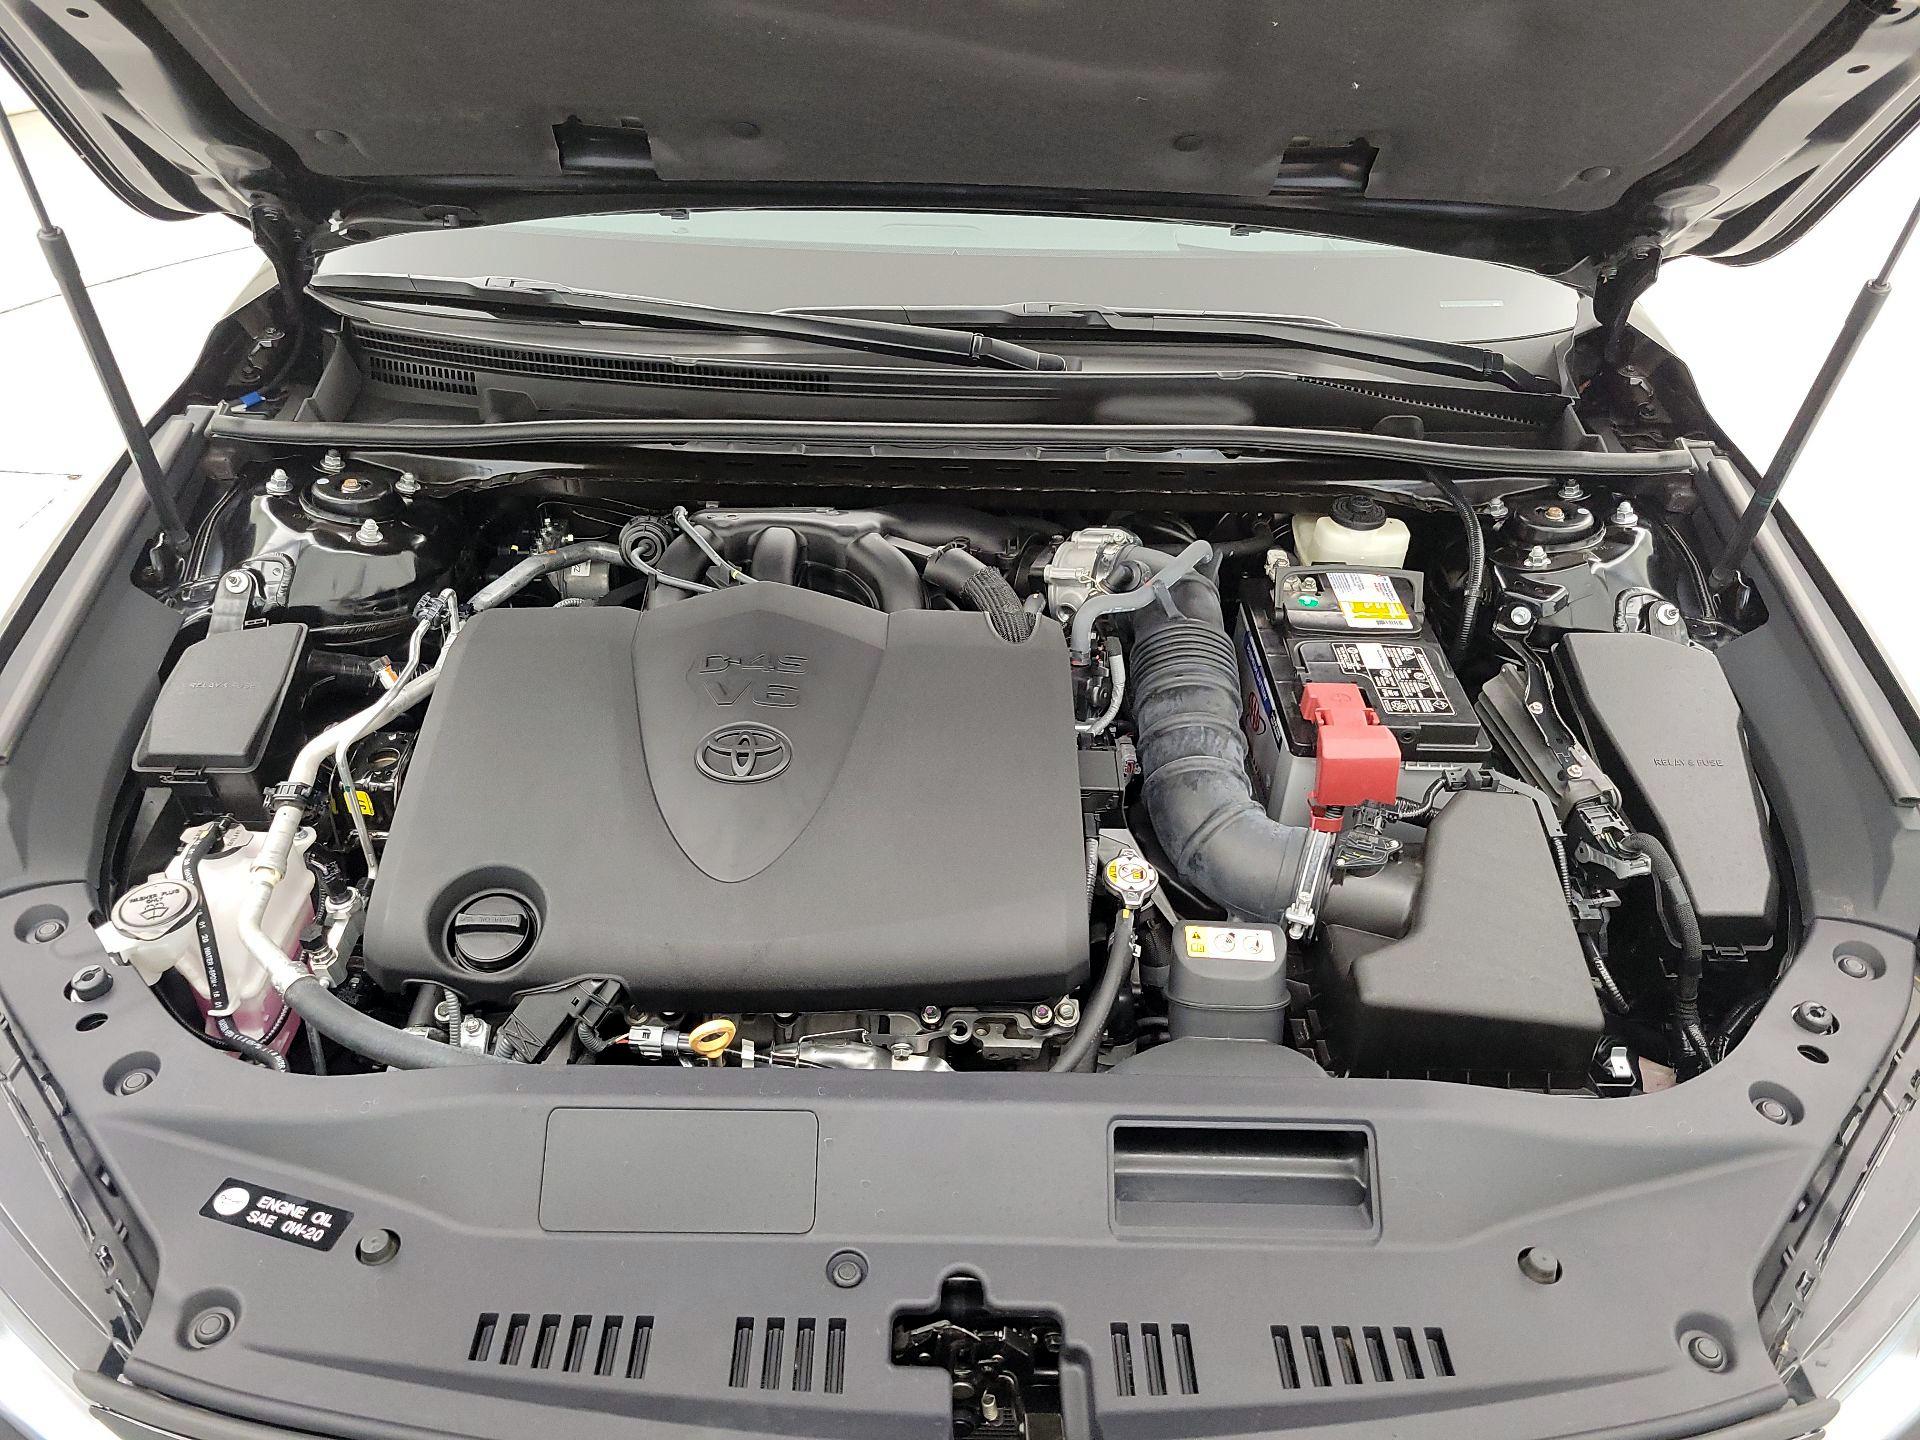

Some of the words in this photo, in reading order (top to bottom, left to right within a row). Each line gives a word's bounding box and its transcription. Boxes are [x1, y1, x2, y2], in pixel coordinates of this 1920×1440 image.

[703, 680, 799, 709] V6
[1653, 758, 1685, 767] RELAY
[1696, 759, 1724, 767] FUSE
[201, 933, 210, 944] 20
[246, 1210, 278, 1229] SAE
[280, 1220, 325, 1242] 0W-20
[256, 1195, 309, 1219] ENGINE
[310, 1211, 333, 1228] OIL
